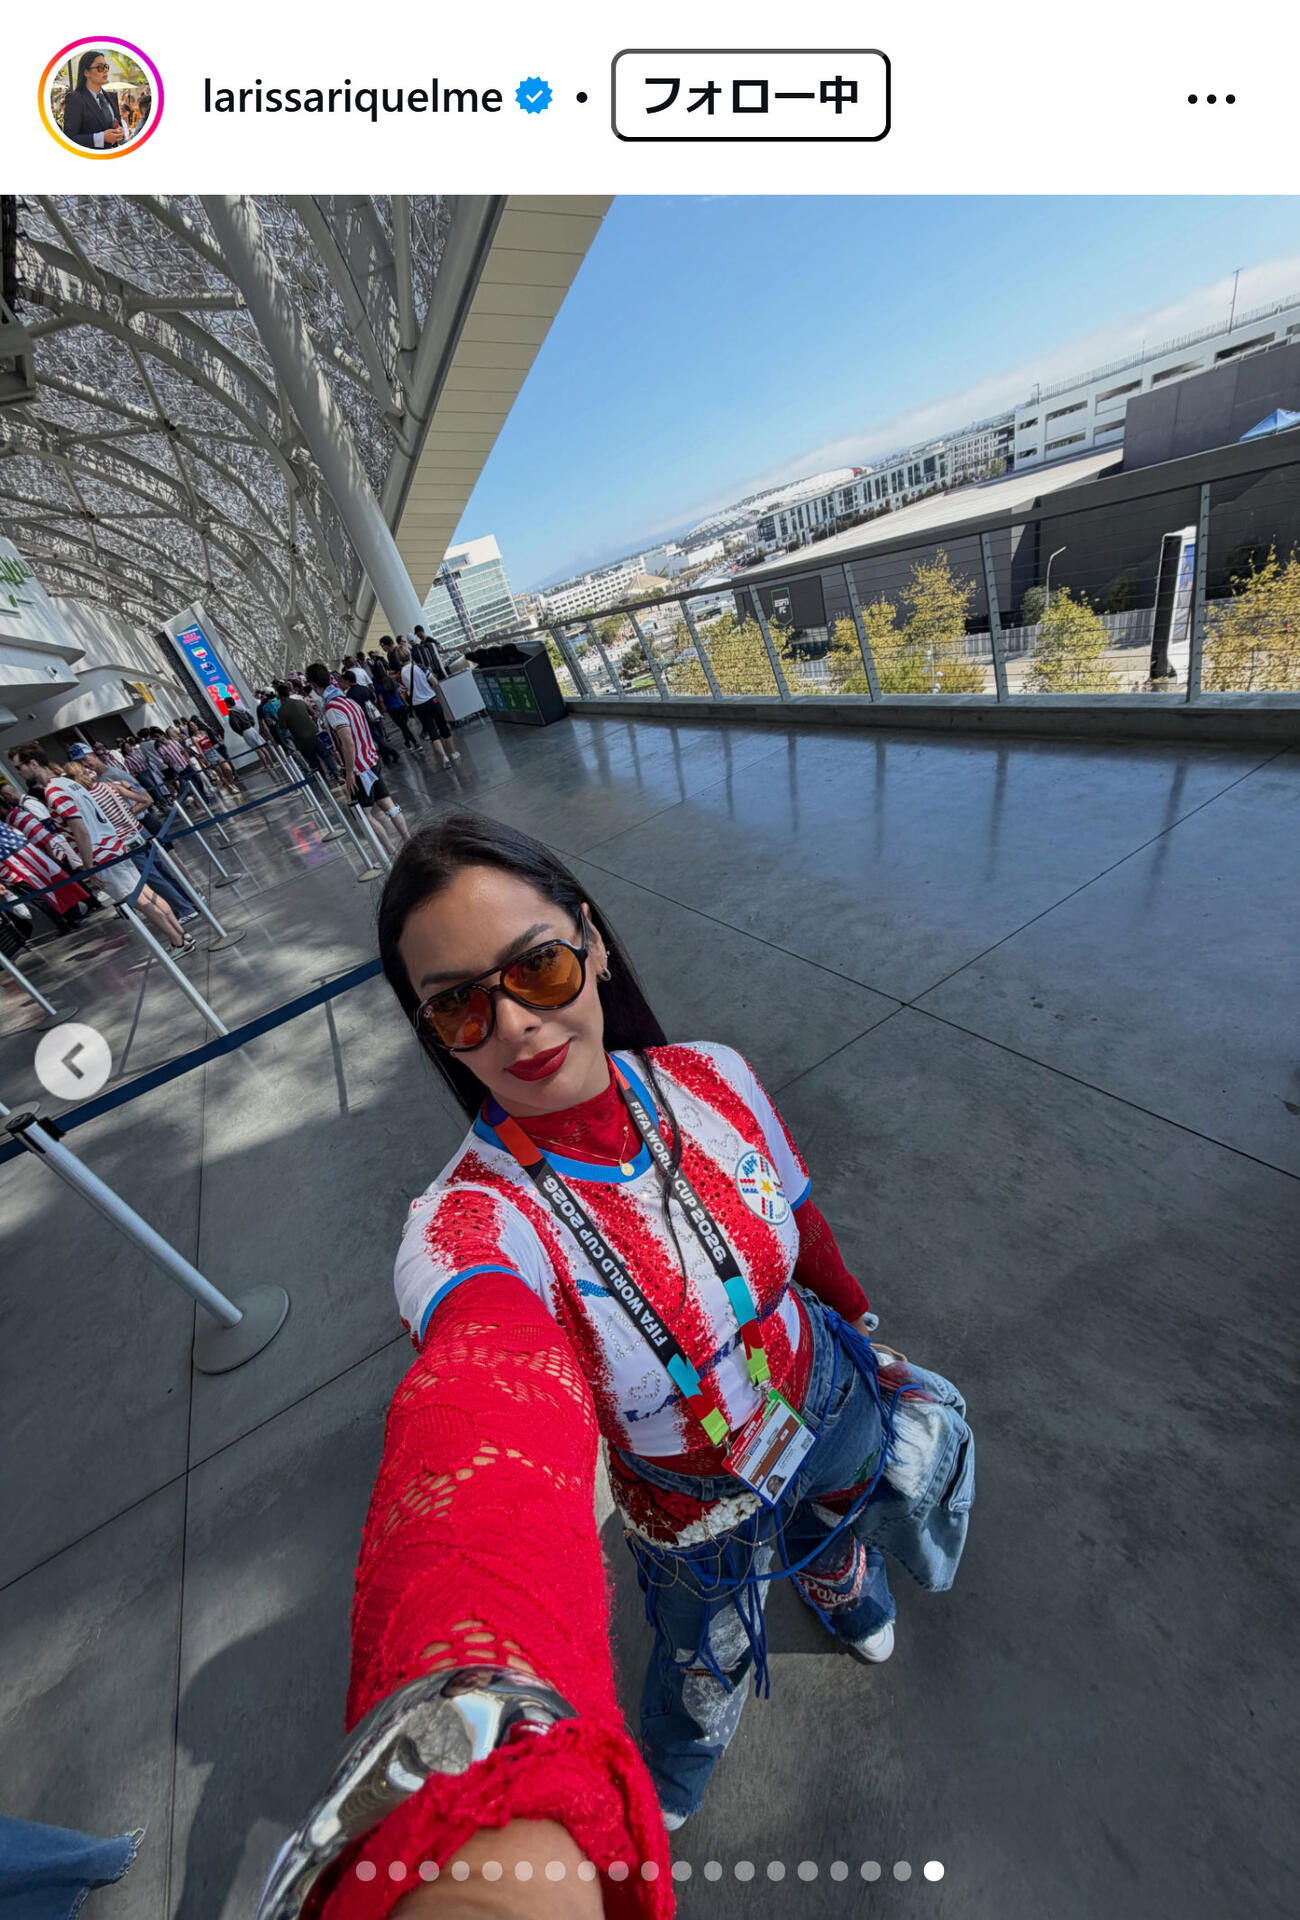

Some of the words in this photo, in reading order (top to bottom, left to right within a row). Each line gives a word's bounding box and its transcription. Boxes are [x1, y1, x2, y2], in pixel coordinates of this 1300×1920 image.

[543, 1175, 585, 1228] 2026
[631, 1101, 651, 1130] FIFA
[674, 1179, 697, 1209] CUP
[691, 1208, 726, 1263] 2026
[579, 1228, 605, 1261] CUP
[601, 1259, 642, 1314] WORLD
[639, 1314, 668, 1347] FIFA
